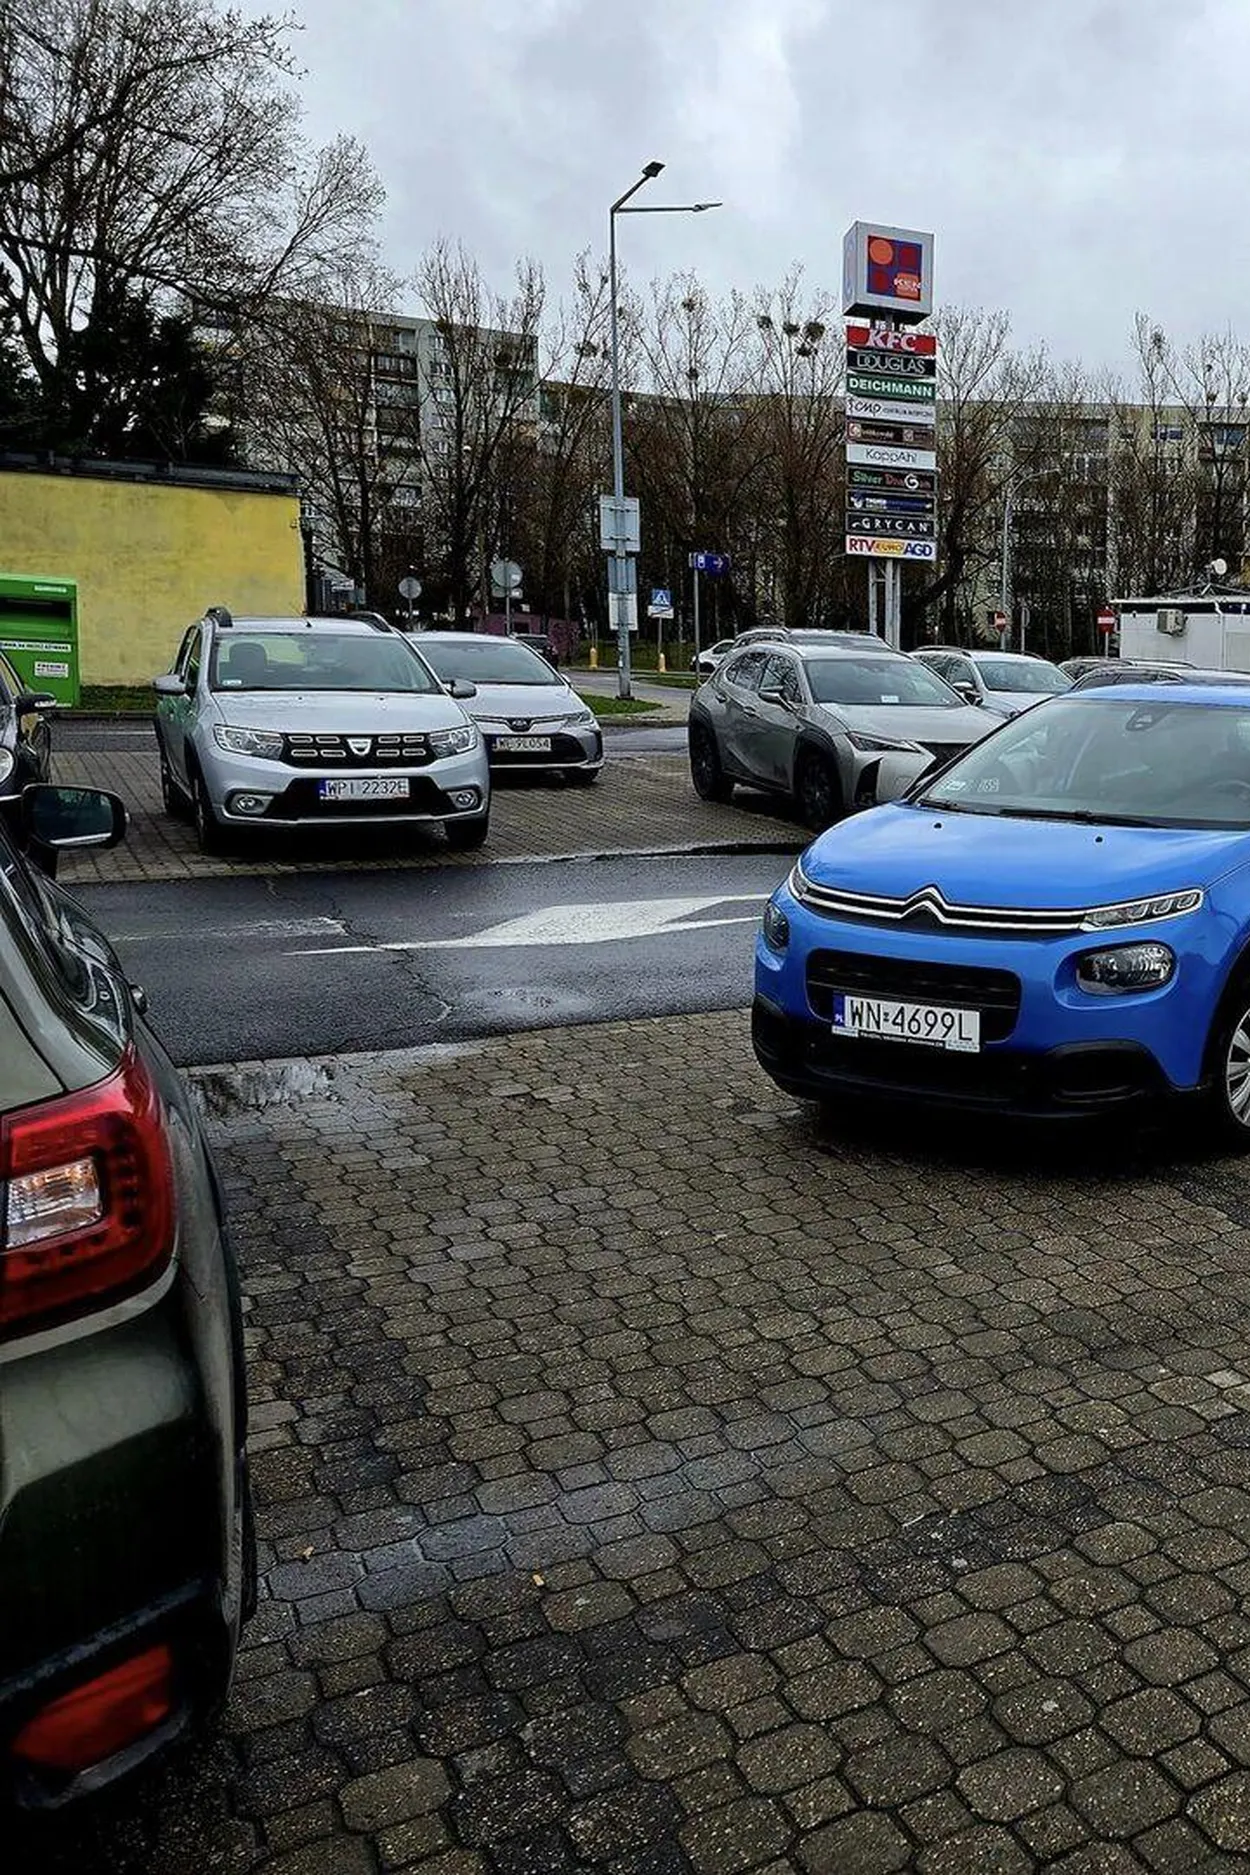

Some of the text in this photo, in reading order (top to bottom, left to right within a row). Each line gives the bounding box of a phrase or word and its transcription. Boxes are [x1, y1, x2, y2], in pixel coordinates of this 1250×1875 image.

[866, 329, 917, 351] KFC
[857, 354, 926, 374] DOUGLAS
[849, 378, 933, 397] DEICHMANN
[861, 518, 928, 533] GRYCAN
[849, 538, 875, 553] RTV
[903, 542, 933, 557] AGD
[850, 1000, 881, 1031] WN
[892, 1005, 973, 1042] 4699L
